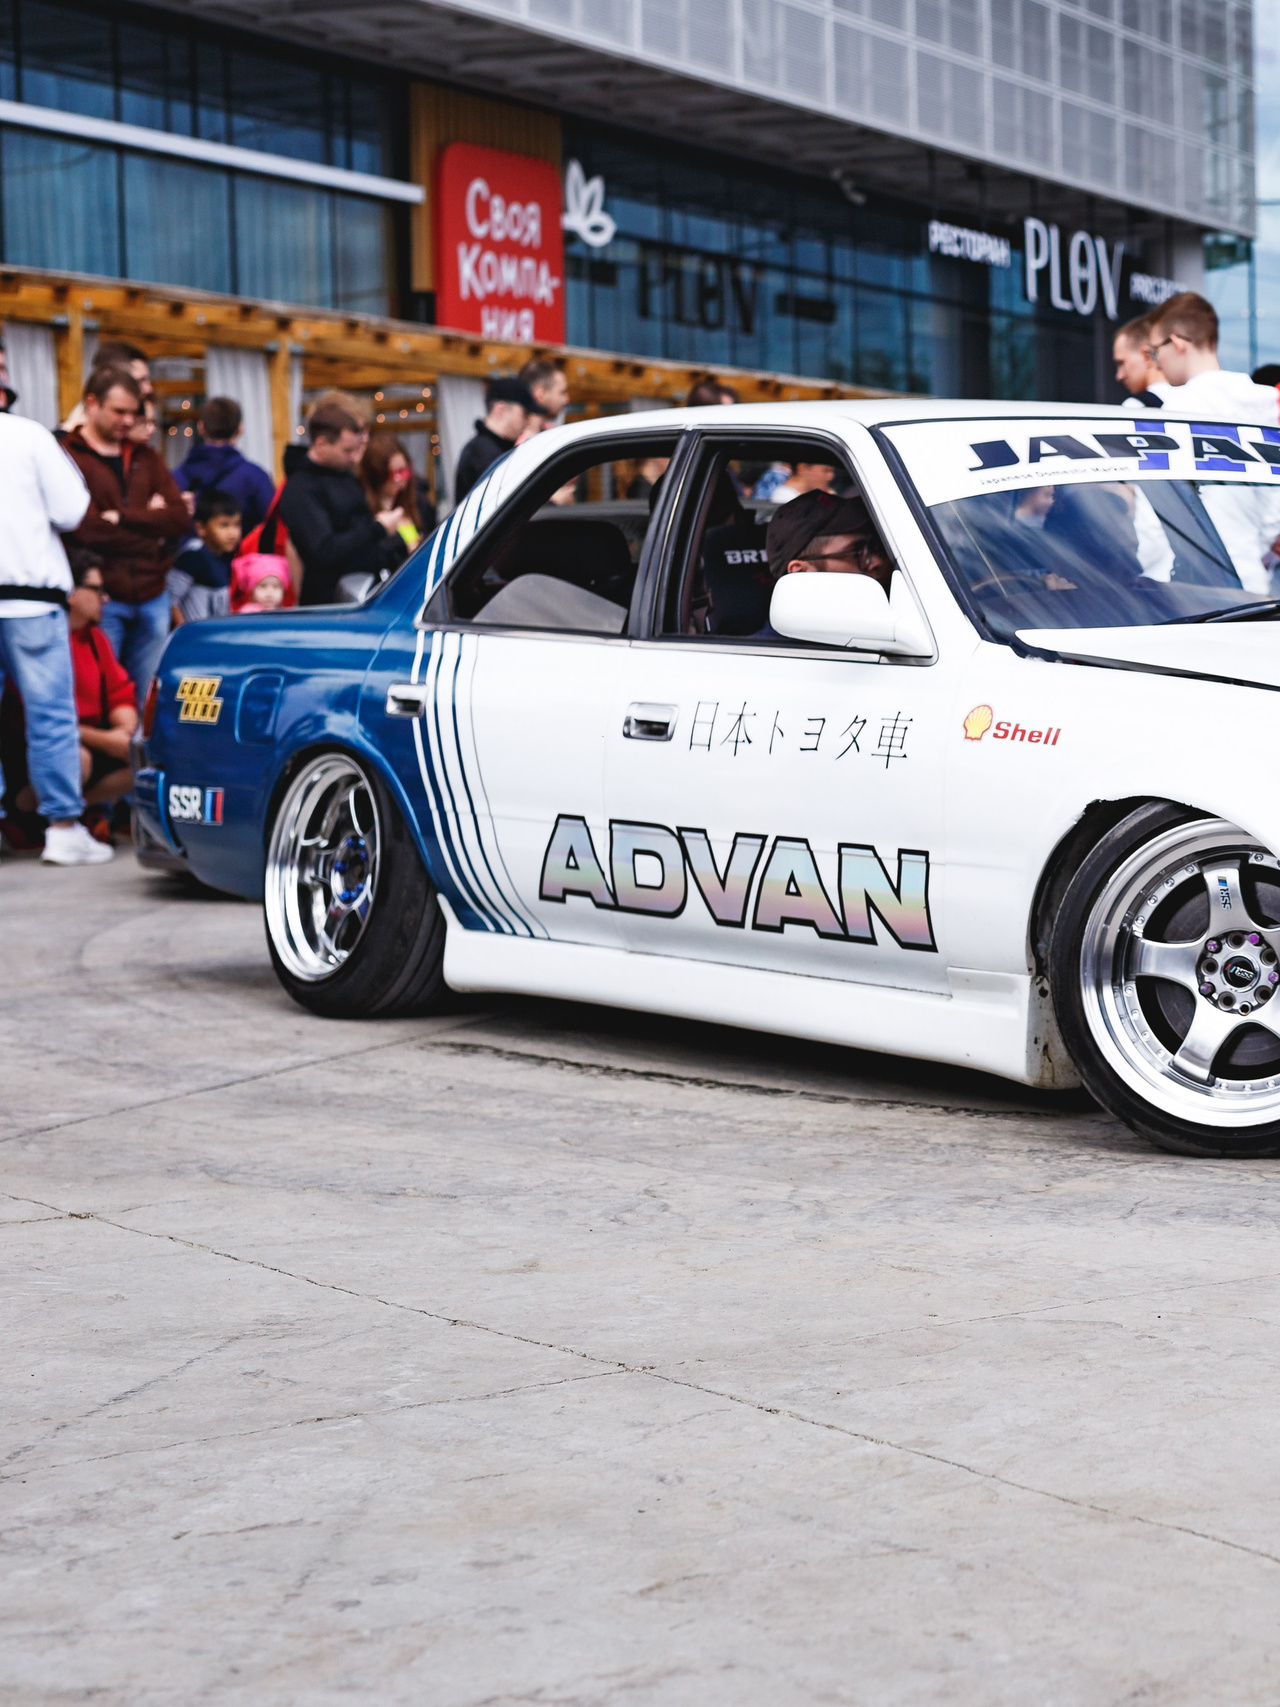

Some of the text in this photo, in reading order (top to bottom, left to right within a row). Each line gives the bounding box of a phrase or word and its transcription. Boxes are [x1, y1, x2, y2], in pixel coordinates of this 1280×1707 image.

[979, 472, 1033, 485] Japanese
[689, 701, 913, 769] 日本トヨタ車
[993, 721, 1061, 746] Shell
[169, 785, 202, 820] SSR
[539, 813, 939, 953] ADVAN
[1219, 886, 1232, 911] SSR
